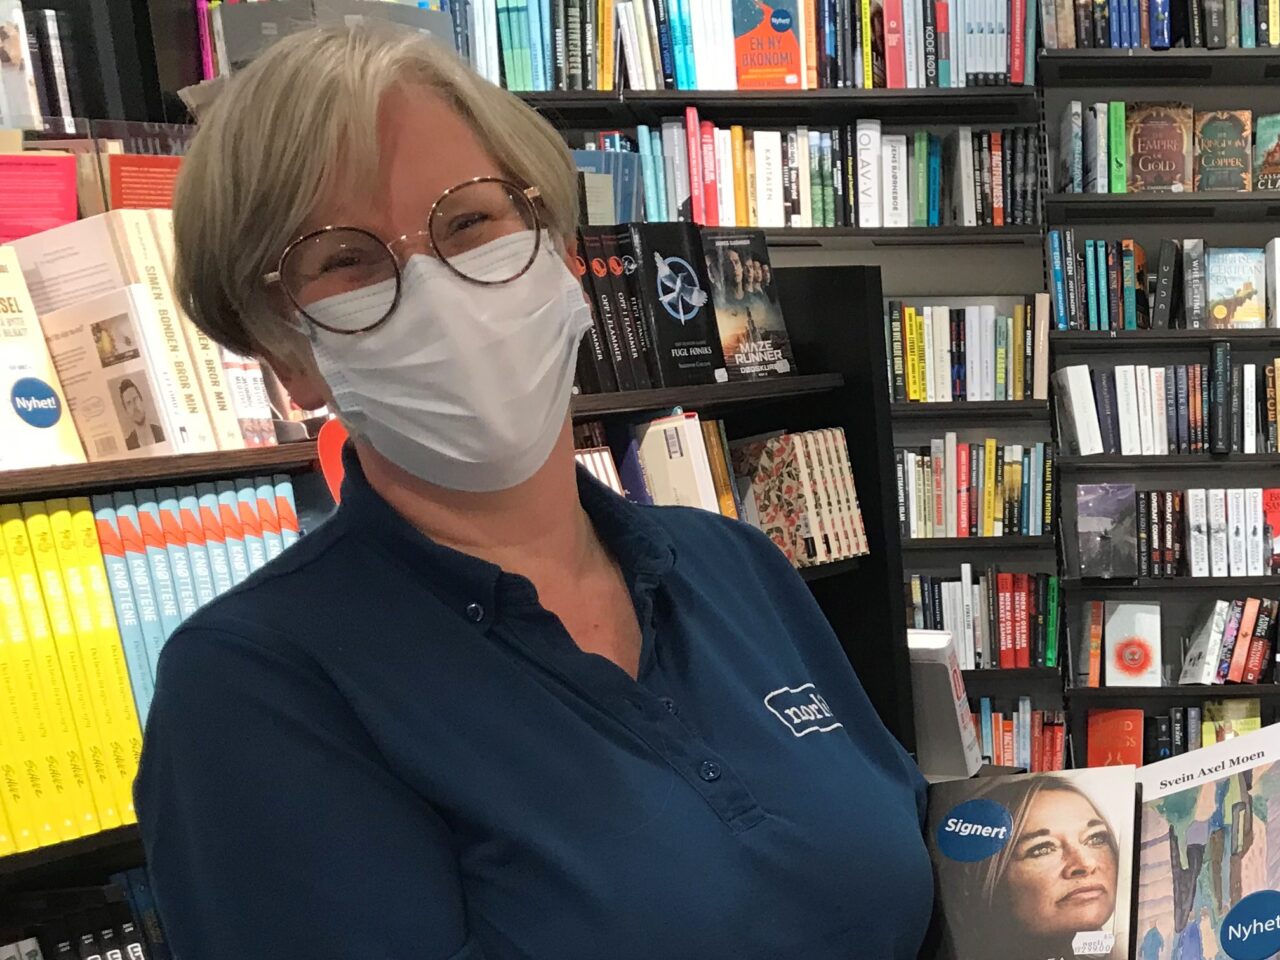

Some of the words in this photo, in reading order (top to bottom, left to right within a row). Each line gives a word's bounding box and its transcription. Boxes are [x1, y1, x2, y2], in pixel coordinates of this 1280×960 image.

[926, 26, 935, 50] KODE
[926, 53, 936, 77] RØD
[764, 148, 774, 202] KAPITALEN
[1138, 155, 1176, 172] GOLD
[1201, 156, 1244, 168] COPPER
[145, 265, 164, 301] SIMEN
[158, 308, 178, 353] BONDEN
[174, 360, 192, 390] BROR
[184, 393, 200, 414] MIN
[606, 317, 622, 362] FLAMMER
[623, 315, 638, 359] FLAMMER
[735, 350, 783, 364] RUNNER
[739, 340, 773, 353] MAZE
[15, 392, 57, 412] Nyhet!
[204, 359, 221, 389] BROR
[213, 391, 229, 411] MIN
[1264, 365, 1276, 422] CIRCE
[112, 563, 137, 626] KNØTTENE
[133, 559, 157, 623] KNØTTENE
[152, 553, 177, 617] KNØTTENE
[174, 551, 196, 614] KNØTTENE
[784, 693, 834, 724] norl
[1159, 771, 1195, 790] Svein
[1197, 761, 1227, 779] Axel
[1229, 751, 1266, 769] Moen
[945, 818, 1007, 840] Signert
